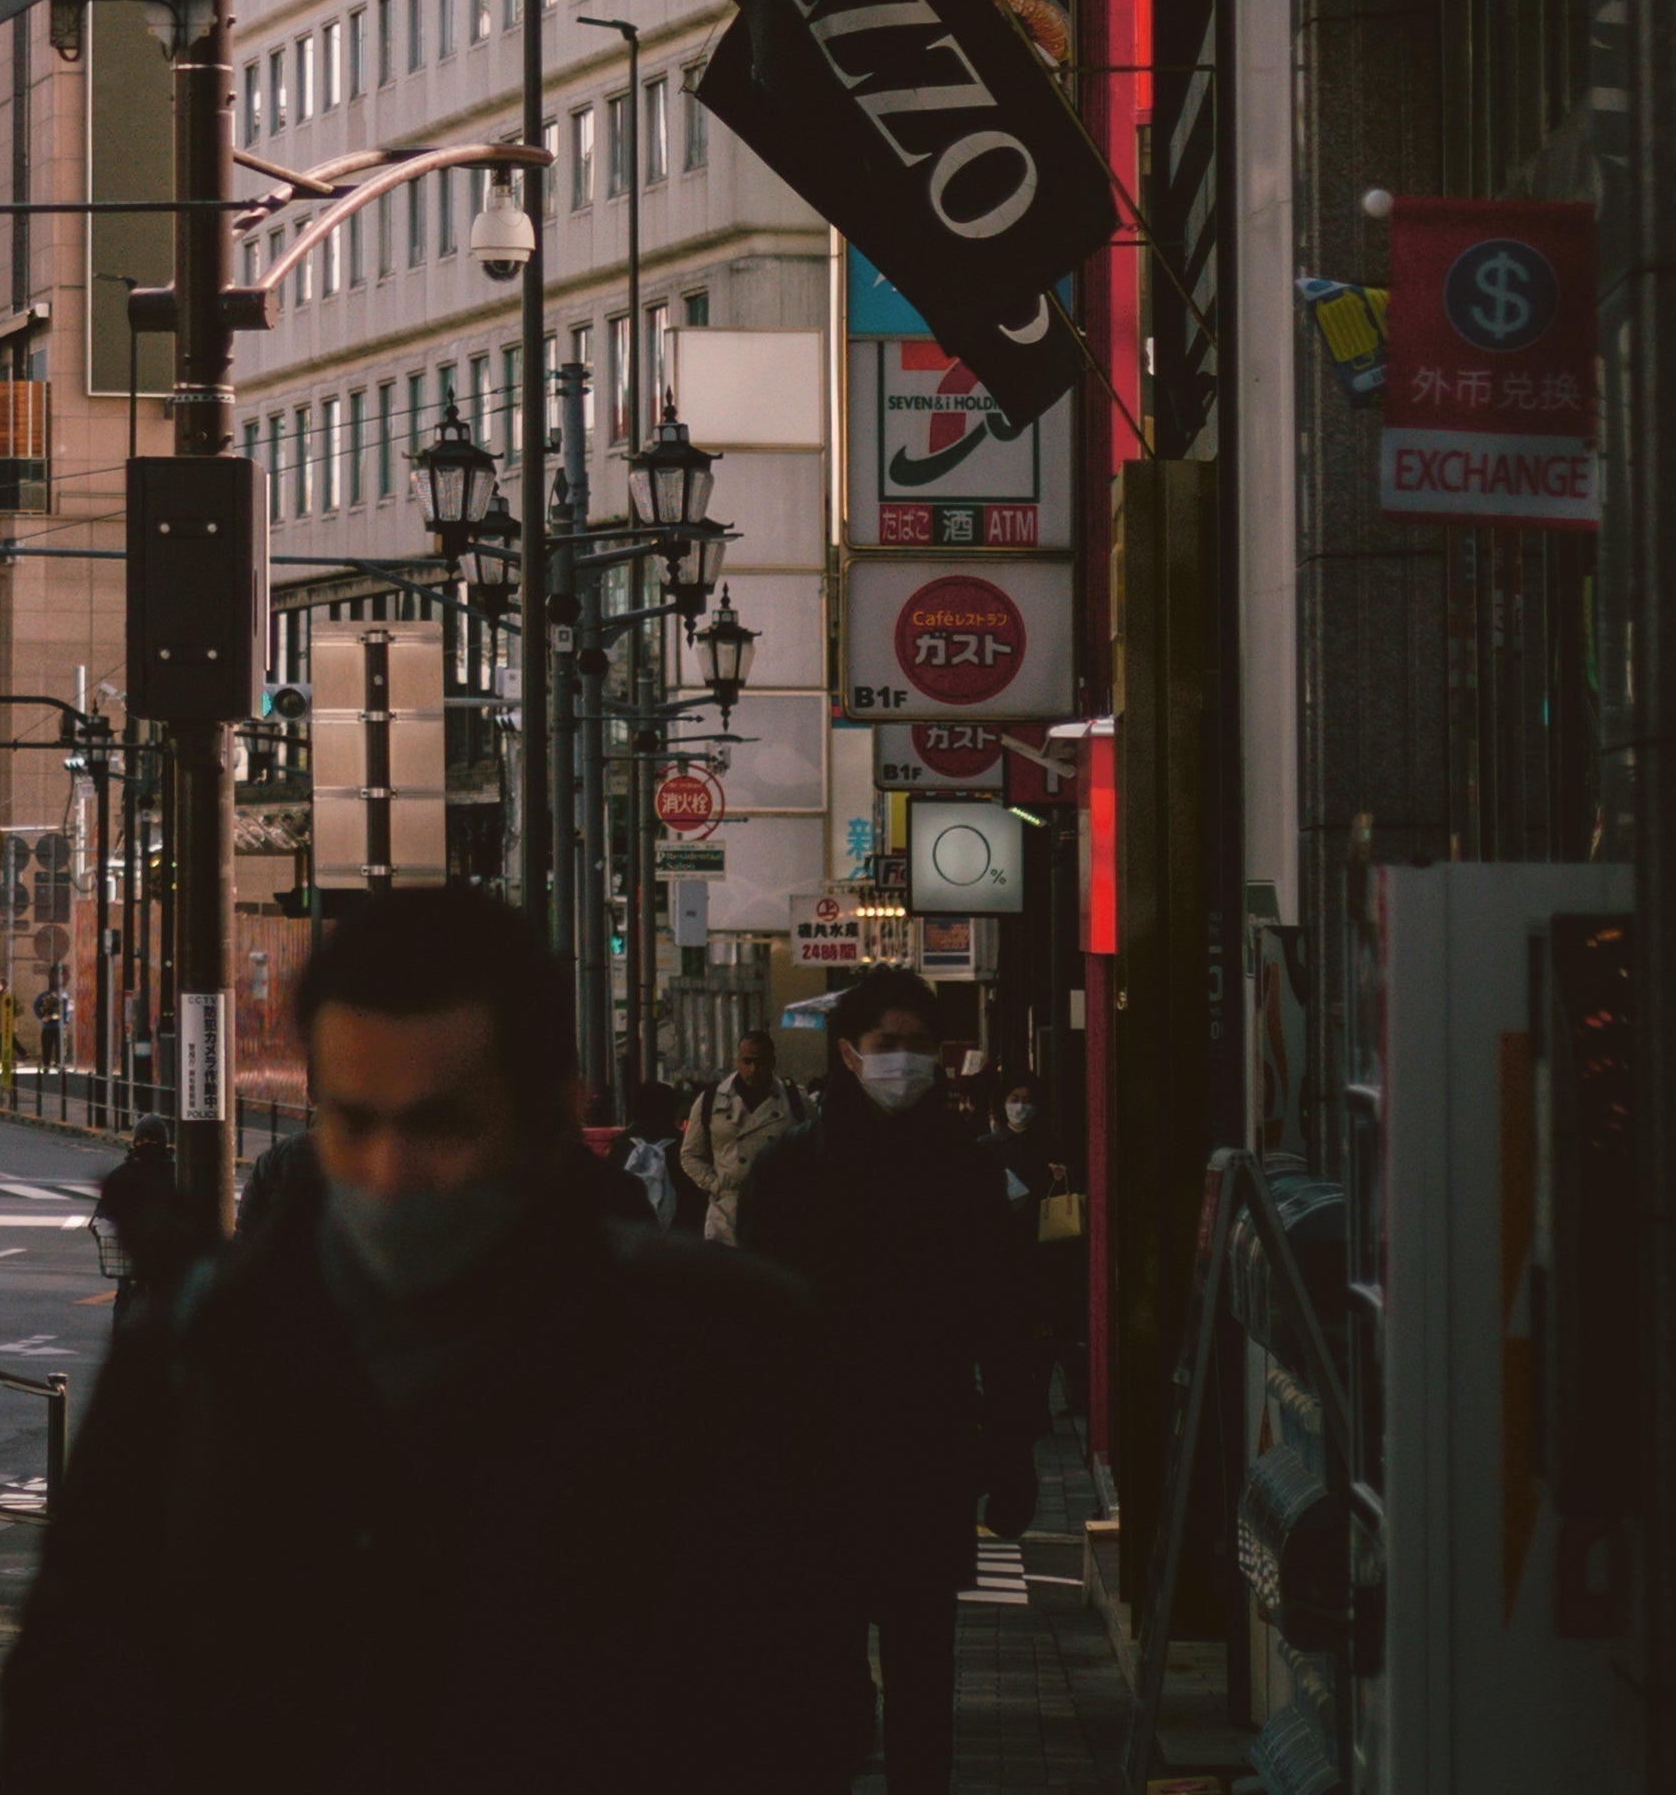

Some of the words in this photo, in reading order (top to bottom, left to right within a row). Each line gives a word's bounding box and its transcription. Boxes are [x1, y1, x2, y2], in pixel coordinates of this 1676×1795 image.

[1411, 366, 1581, 412] 外币兑换
[1394, 448, 1589, 500] EXCHANGE
[882, 511, 931, 541] たばこ
[943, 510, 974, 543] 酒
[989, 510, 1035, 543] ATM
[914, 633, 1012, 668] ガスト
[854, 687, 909, 710] B1F
[926, 725, 998, 750] ガスト
[883, 764, 922, 782] B1F
[662, 792, 709, 815] 消火栓
[801, 943, 857, 961] 24時間
